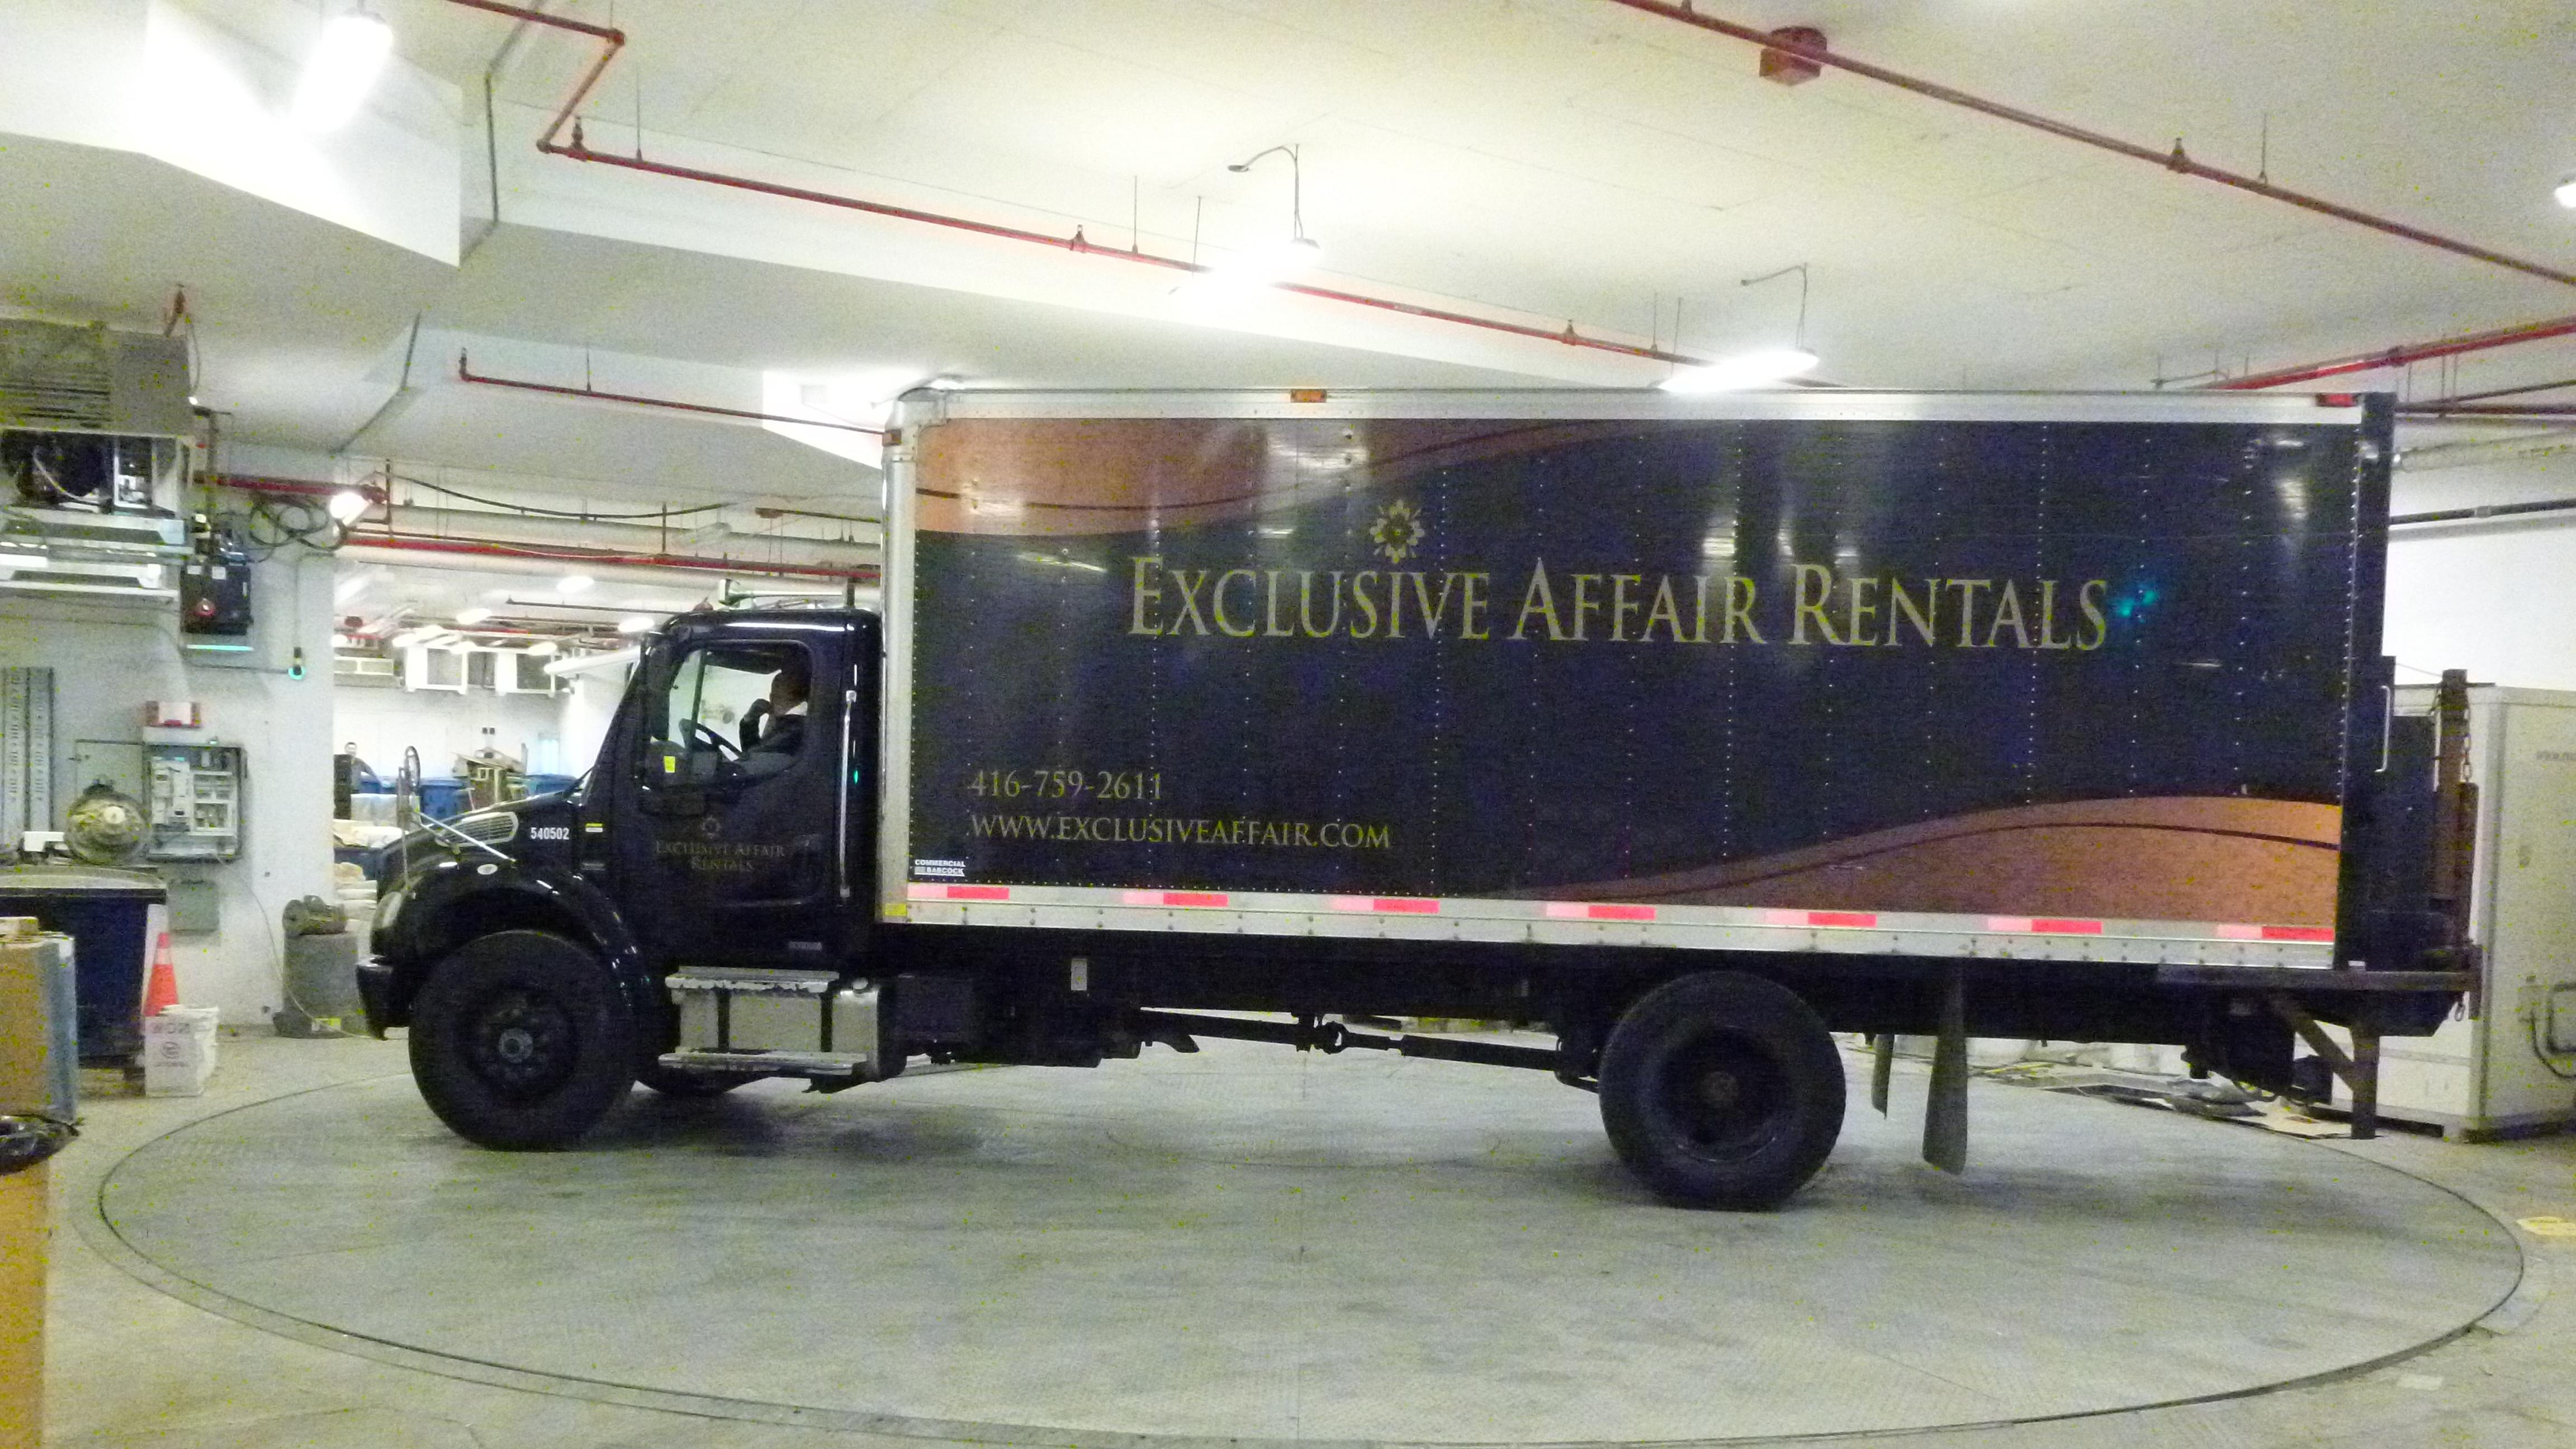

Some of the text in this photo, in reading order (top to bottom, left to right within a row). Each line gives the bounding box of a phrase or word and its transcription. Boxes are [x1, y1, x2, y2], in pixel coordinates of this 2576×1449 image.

[1128, 556, 2108, 651] EXCLUSIVE AFFAIR RENTALS
[968, 769, 1162, 800] 416-759-2611
[531, 827, 570, 840] 540502
[970, 814, 1390, 849] WWW.EXCLUSIVEAFFAIR.COM
[915, 859, 966, 868] COMMERCIAL
